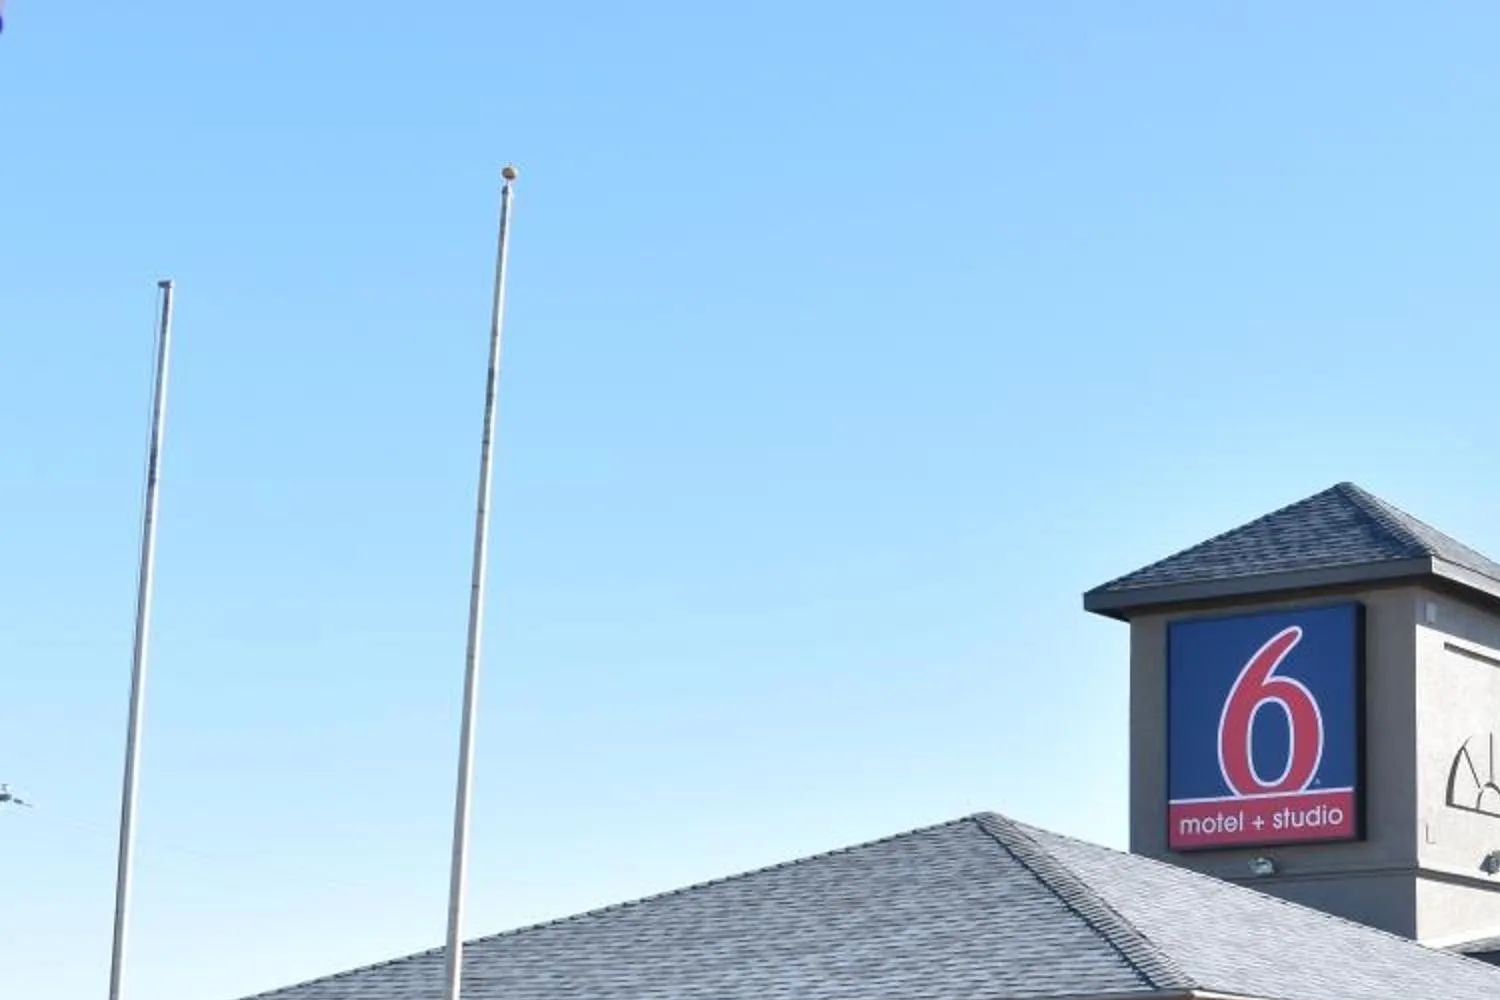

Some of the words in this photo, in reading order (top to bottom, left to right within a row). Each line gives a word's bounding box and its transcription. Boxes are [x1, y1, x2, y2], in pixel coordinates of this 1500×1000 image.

[1219, 625, 1324, 798] 6
[1180, 810, 1244, 835] motel
[1251, 815, 1265, 831] +
[1272, 805, 1343, 829] studio
